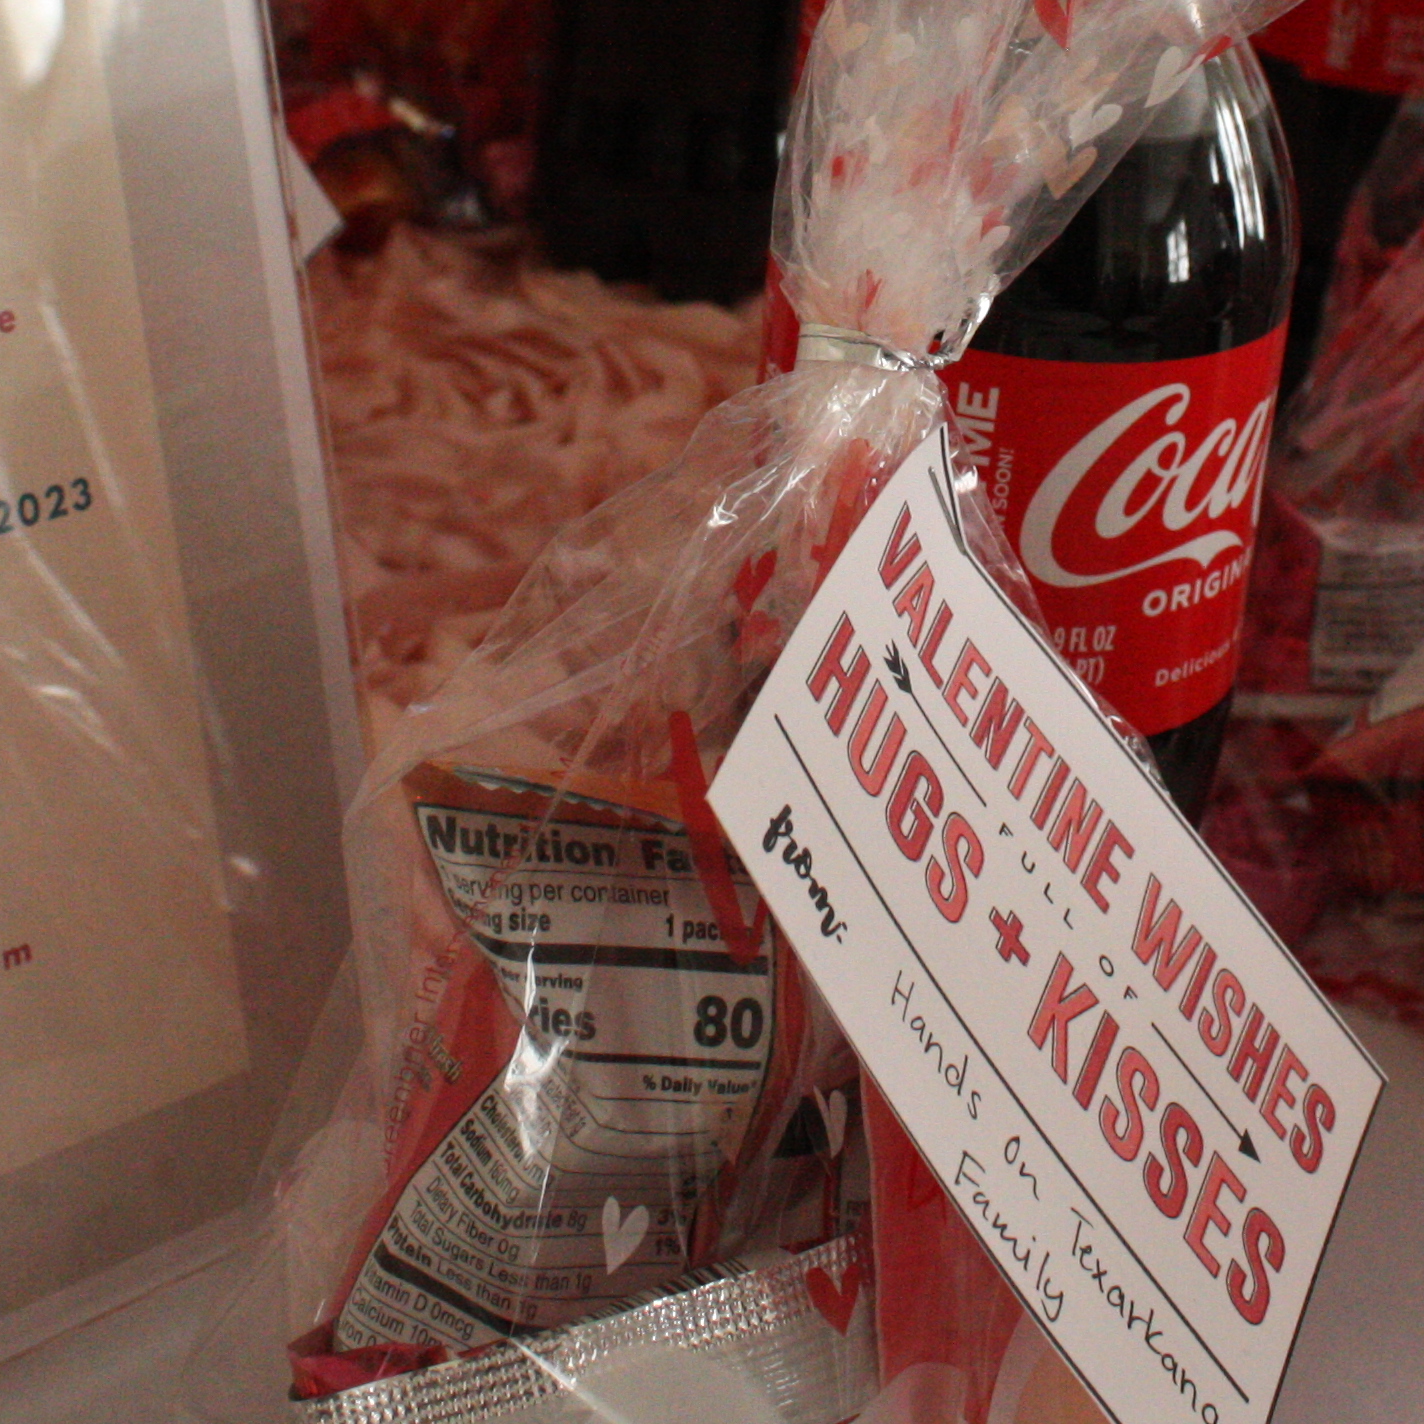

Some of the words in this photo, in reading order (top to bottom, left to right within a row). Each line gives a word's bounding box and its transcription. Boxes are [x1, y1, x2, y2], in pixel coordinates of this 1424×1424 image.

[994, 447, 1015, 517] SOON!
[1069, 627, 1088, 653] FL
[1093, 625, 1117, 652] OZ
[426, 814, 617, 868] Nutrition
[877, 501, 1135, 914] VALENTINE
[1131, 873, 1336, 1174] WISHES
[509, 909, 552, 933] size
[530, 883, 564, 910] per
[998, 824, 1076, 930] FULL
[1098, 955, 1140, 1002] OF
[805, 611, 985, 924] HUGS
[989, 906, 1031, 966] +
[1027, 952, 1286, 1326] KISSES
[692, 994, 764, 1050] 80
[889, 969, 983, 1121] Hands
[1002, 1136, 1041, 1203] On
[431, 1227, 486, 1272] Sugars
[458, 1213, 495, 1249] Fiber
[956, 1150, 1066, 1323] Family
[350, 1286, 405, 1332] Calcium
[412, 1293, 427, 1314] D
[436, 1258, 473, 1293] Less
[476, 1280, 512, 1310] than
